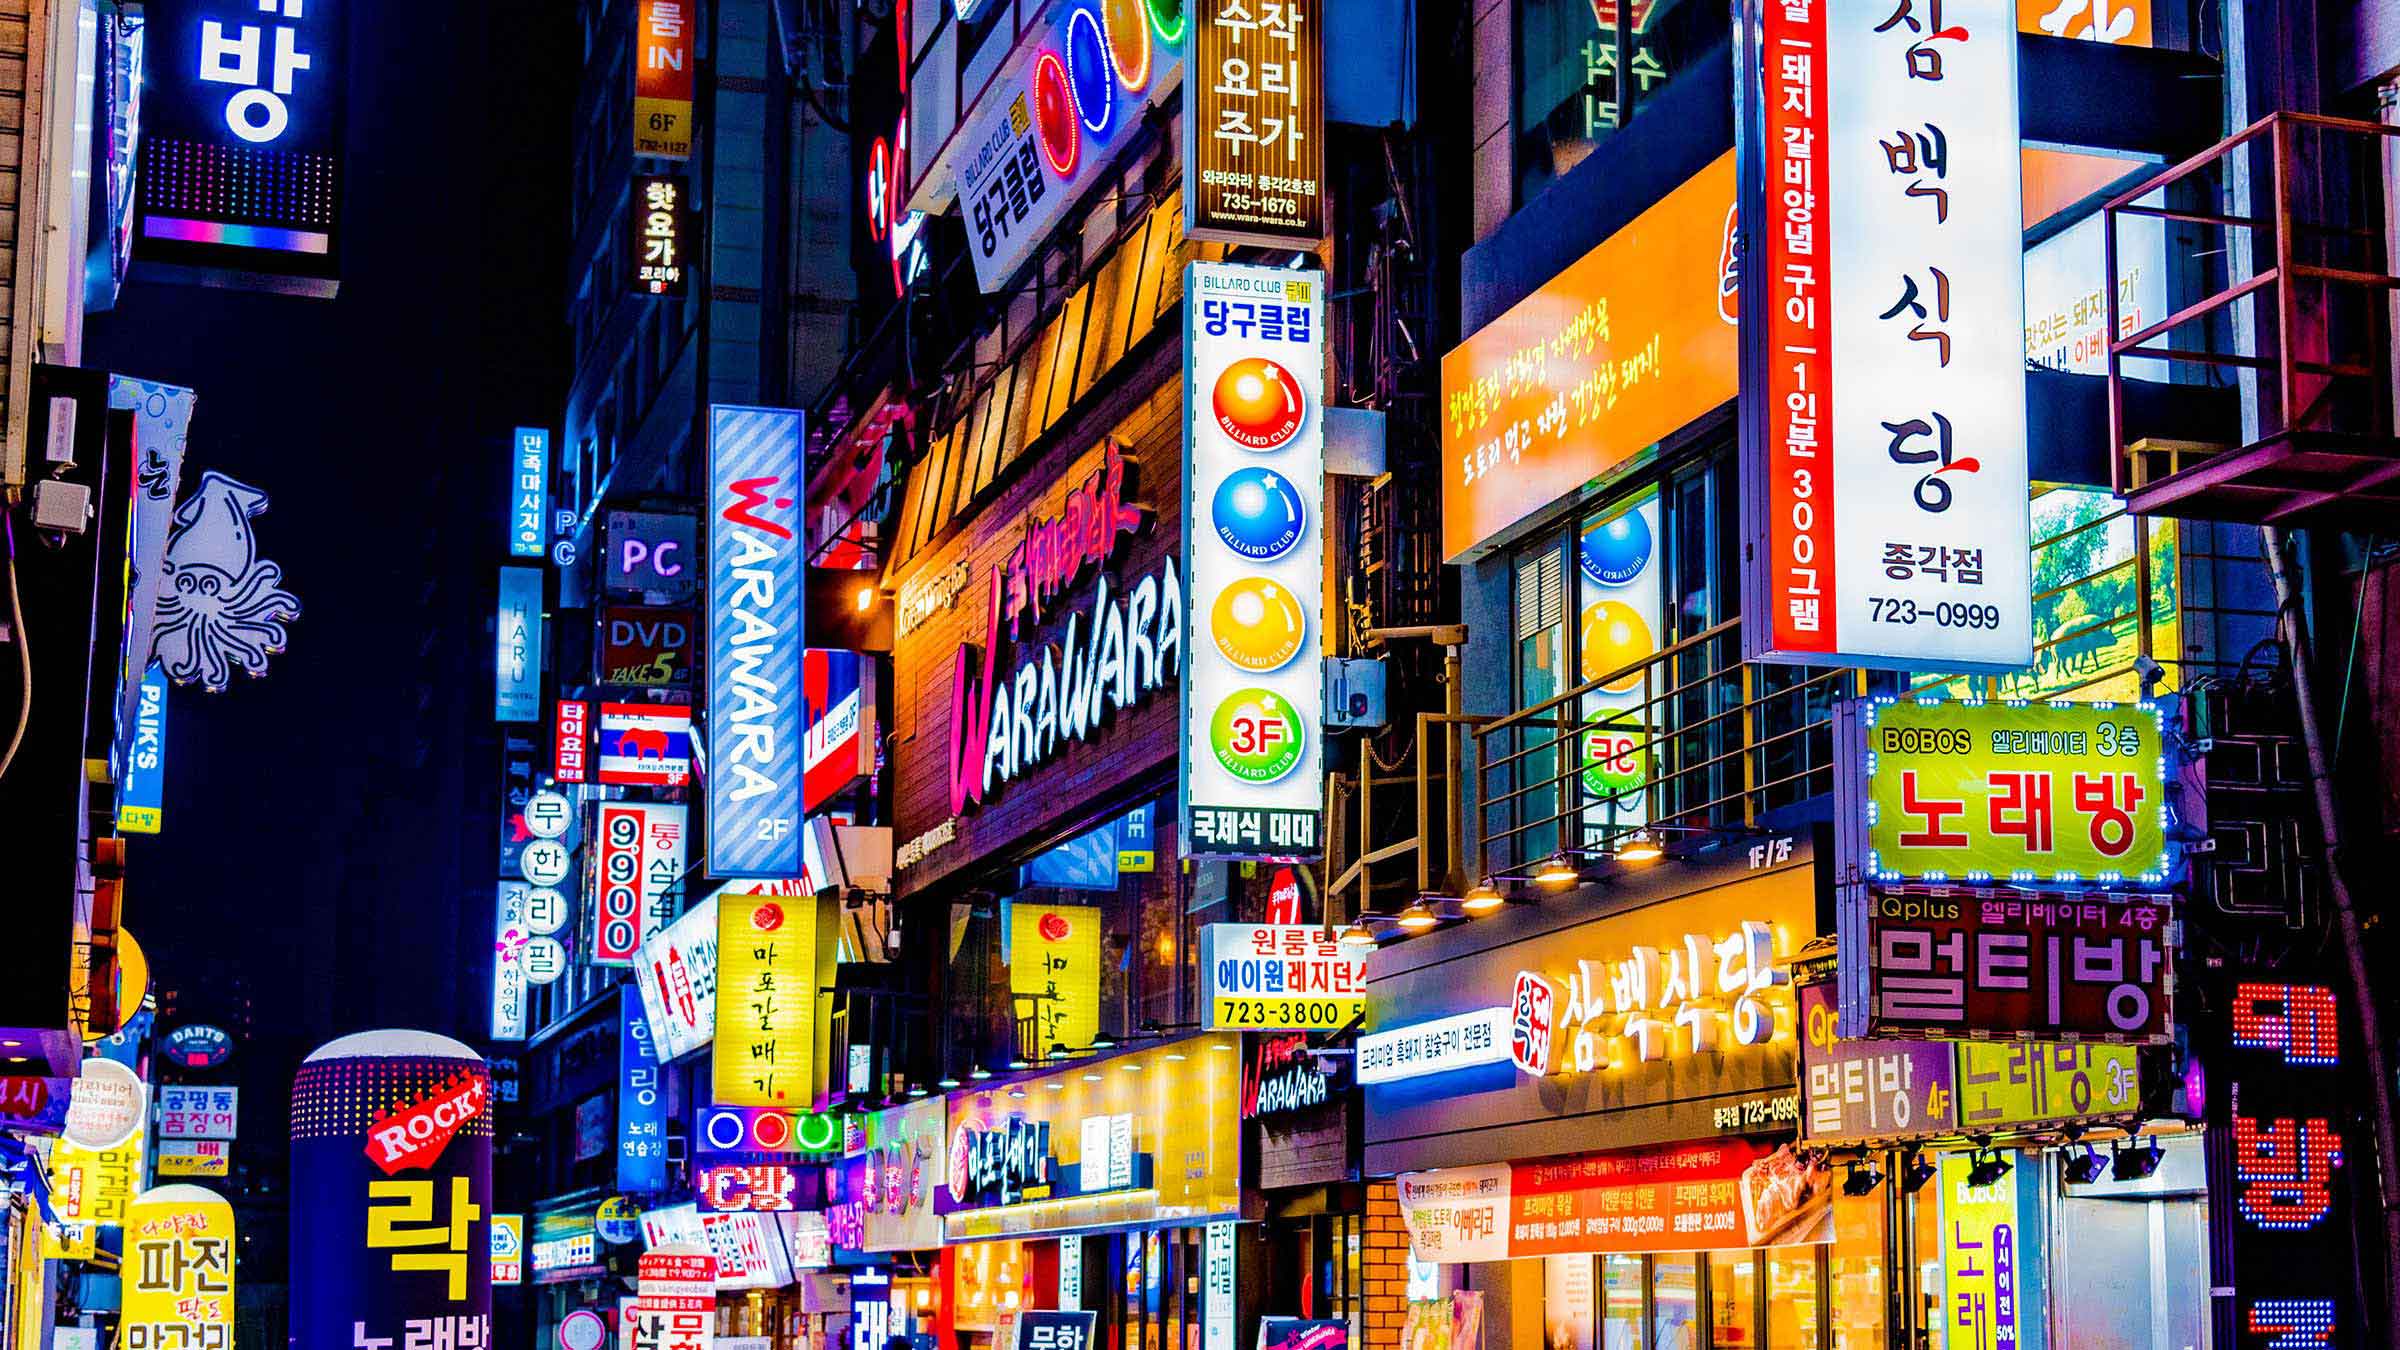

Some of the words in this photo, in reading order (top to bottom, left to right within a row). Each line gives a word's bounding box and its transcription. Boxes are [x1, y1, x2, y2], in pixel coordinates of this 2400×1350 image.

[1214, 0, 1304, 51] 수작
[199, 0, 310, 142] 방
[648, 46, 683, 70] IN
[1214, 58, 1297, 108] 요리
[1781, 55, 1812, 118] 돼지
[650, 113, 677, 132] 6F
[1214, 110, 1304, 161] 주가
[974, 133, 1046, 258] 당구클럽
[1202, 170, 1253, 188] 와라와라
[1258, 175, 1316, 195] 종각2호점
[1222, 193, 1297, 215] 735-1676
[1783, 127, 1815, 255] 갈비양념
[645, 182, 676, 266] 핫요가
[1211, 211, 1306, 228] www.wara-wara.co.kr
[1873, 0, 1980, 513] 삼백식당
[1254, 280, 1281, 294] CLUB
[1783, 264, 1816, 329] 구이
[1203, 300, 1311, 343] 당구클럽
[1221, 415, 1268, 446] BILLIARD
[1270, 419, 1295, 443] CLUB
[1785, 362, 1818, 458] 1인분
[623, 540, 682, 576] PC
[1220, 526, 1268, 556] BILLIARD
[1269, 529, 1295, 553] CLUB
[1883, 542, 1983, 585] 종각점
[611, 621, 686, 648] DVD
[1868, 597, 2000, 630] 723-0999
[511, 602, 528, 684] HARU
[1219, 636, 1267, 666] BILLIARD
[1269, 639, 1295, 663] CLUB
[950, 554, 1182, 817] WARAWARA
[137, 684, 161, 769] PAIK'S
[559, 704, 585, 768] 타이요리
[1232, 718, 1283, 753] 3F
[1883, 728, 1972, 754] BOBOS
[1991, 732, 2088, 756] 엘리베이터
[2096, 722, 2141, 757] 3층
[1219, 749, 1267, 778] BILLIARD
[1269, 752, 1295, 776] CLUB
[757, 819, 789, 840] 2F
[1194, 810, 1261, 846] 국제식
[1269, 814, 1316, 848] 대대
[1899, 770, 2146, 858] 노래방
[528, 802, 562, 974] 무한리필
[1882, 897, 1960, 921] Qplus
[1981, 902, 2108, 930] 엘리베이터
[2120, 906, 2160, 930] 4층
[1559, 919, 1791, 1073] 삼백식당
[1880, 930, 2161, 1032] 멀티방
[747, 942, 779, 1100] 마포갈매기
[1223, 1001, 1338, 1024] 723-3800
[1362, 1044, 1394, 1071] 프리미엄
[1396, 1038, 1422, 1063] 흑돼지
[1463, 1024, 1493, 1050] 전문점
[1811, 1052, 1914, 1133] 멀티방
[1926, 1081, 1949, 1121] 4F
[1966, 1043, 2092, 1121] 노래방
[2105, 1058, 2137, 1104] 3F
[374, 1091, 477, 1163] ROCK
[628, 1122, 658, 1137] 노래
[366, 1176, 481, 1301] 락
[138, 1240, 229, 1291] 파전
[1955, 1220, 1986, 1350] 노래
[1996, 1325, 2015, 1342] 50%
